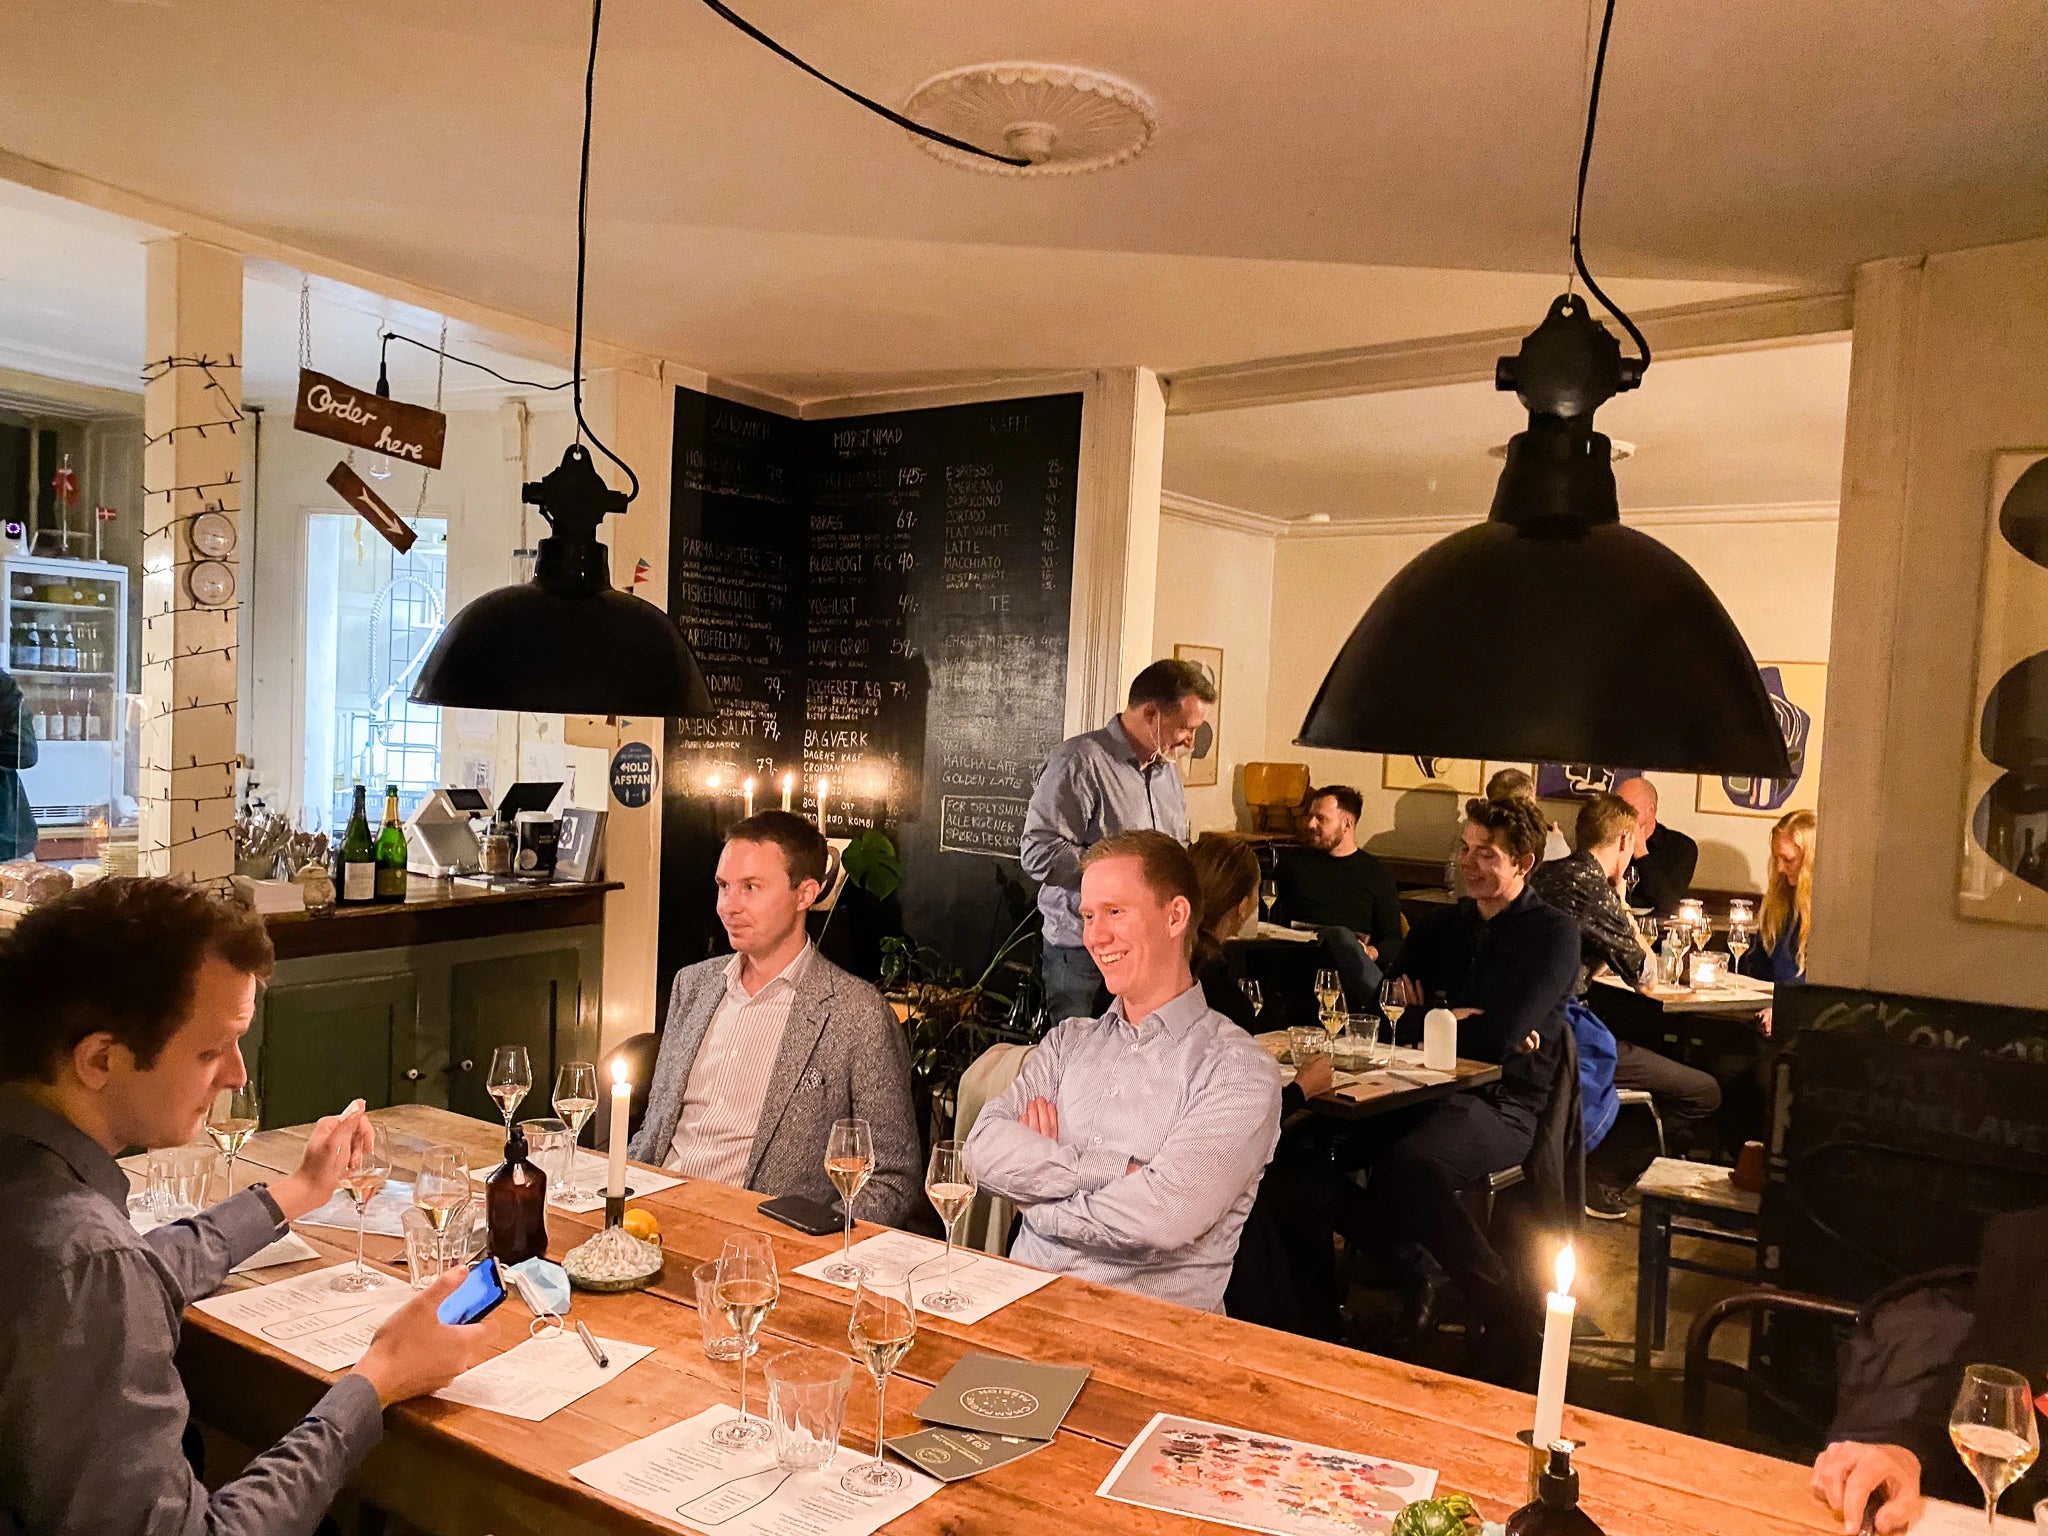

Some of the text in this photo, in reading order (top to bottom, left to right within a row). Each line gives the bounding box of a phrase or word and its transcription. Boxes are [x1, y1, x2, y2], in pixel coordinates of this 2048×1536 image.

[307, 384, 377, 426] Order
[375, 425, 424, 460] here
[833, 427, 904, 448] MORGENMAD
[946, 463, 994, 481] ESPRESSO
[947, 479, 1003, 494] AMERICANO
[946, 495, 1002, 508] CAPPUCCINO
[946, 508, 987, 523] CORTADO
[972, 523, 1009, 539] WHITE
[945, 539, 980, 555] LATTE
[809, 554, 862, 573] BLØDKOGT
[873, 554, 893, 572] ÆG
[944, 556, 1001, 569] MACCHIATO
[808, 597, 857, 615] YOGHURT
[989, 594, 1011, 612] TE
[806, 678, 858, 696] POCHERET
[864, 680, 882, 700] ÆG
[678, 718, 717, 737] DAGENS
[721, 719, 757, 737] SALAT
[804, 728, 868, 748] BAGVÆRK
[803, 748, 836, 762] DAGENS
[624, 762, 649, 773] HOLD
[614, 774, 651, 786] AFSTAN
[942, 770, 1022, 789] GOLDEN LATTE
[945, 799, 966, 813] FOR
[848, 816, 875, 829] KOMBI
[945, 815, 1015, 833] ALLERGENER
[945, 828, 1021, 848] SPØRG PERSON
[978, 1388, 1031, 1402] PASSION
[966, 1396, 1031, 1417] CHAMPAGNE
